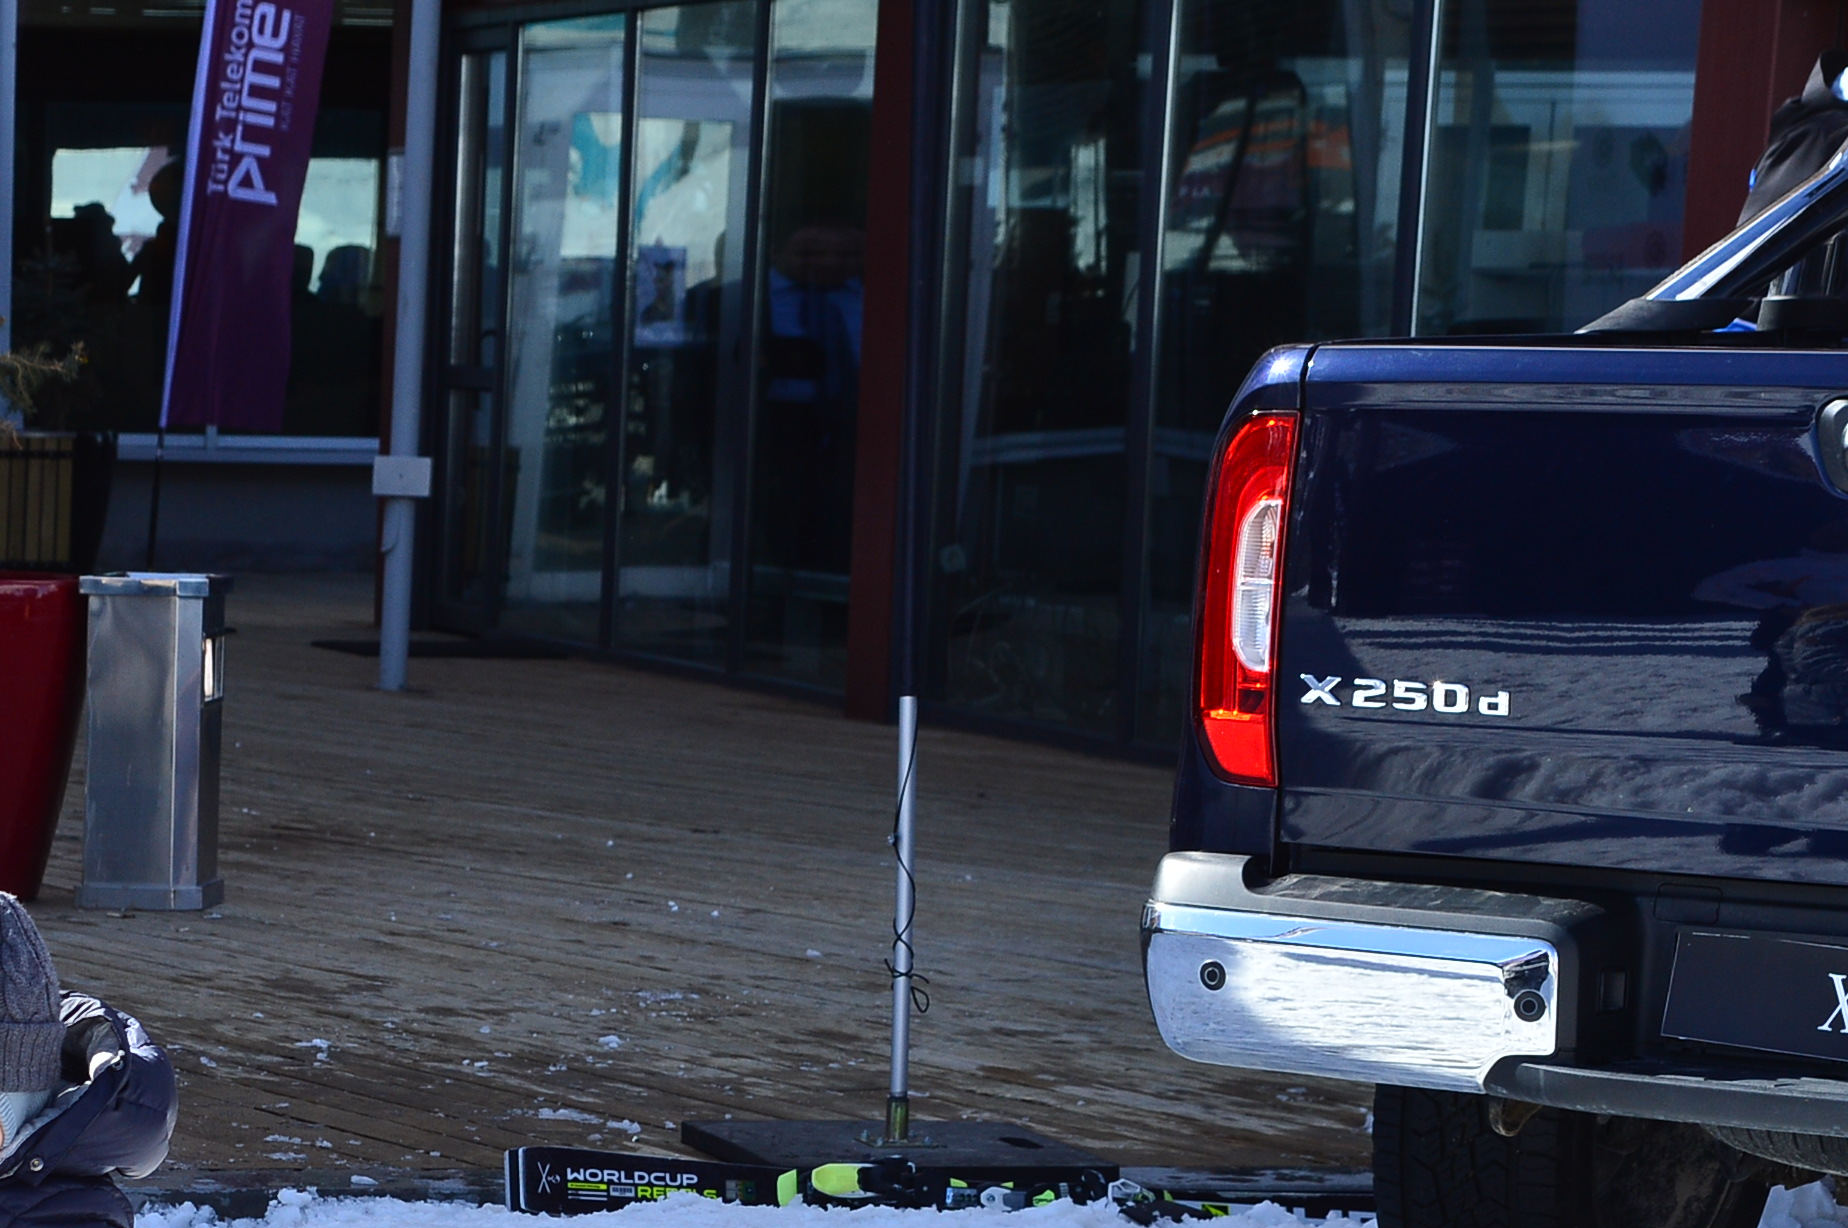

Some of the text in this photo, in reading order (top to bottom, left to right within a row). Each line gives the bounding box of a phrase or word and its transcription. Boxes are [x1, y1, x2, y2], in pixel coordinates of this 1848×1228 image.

[207, 0, 253, 195] Türk Telekom
[566, 1167, 698, 1187] WORLDCUP
[637, 1186, 718, 1200] RES
